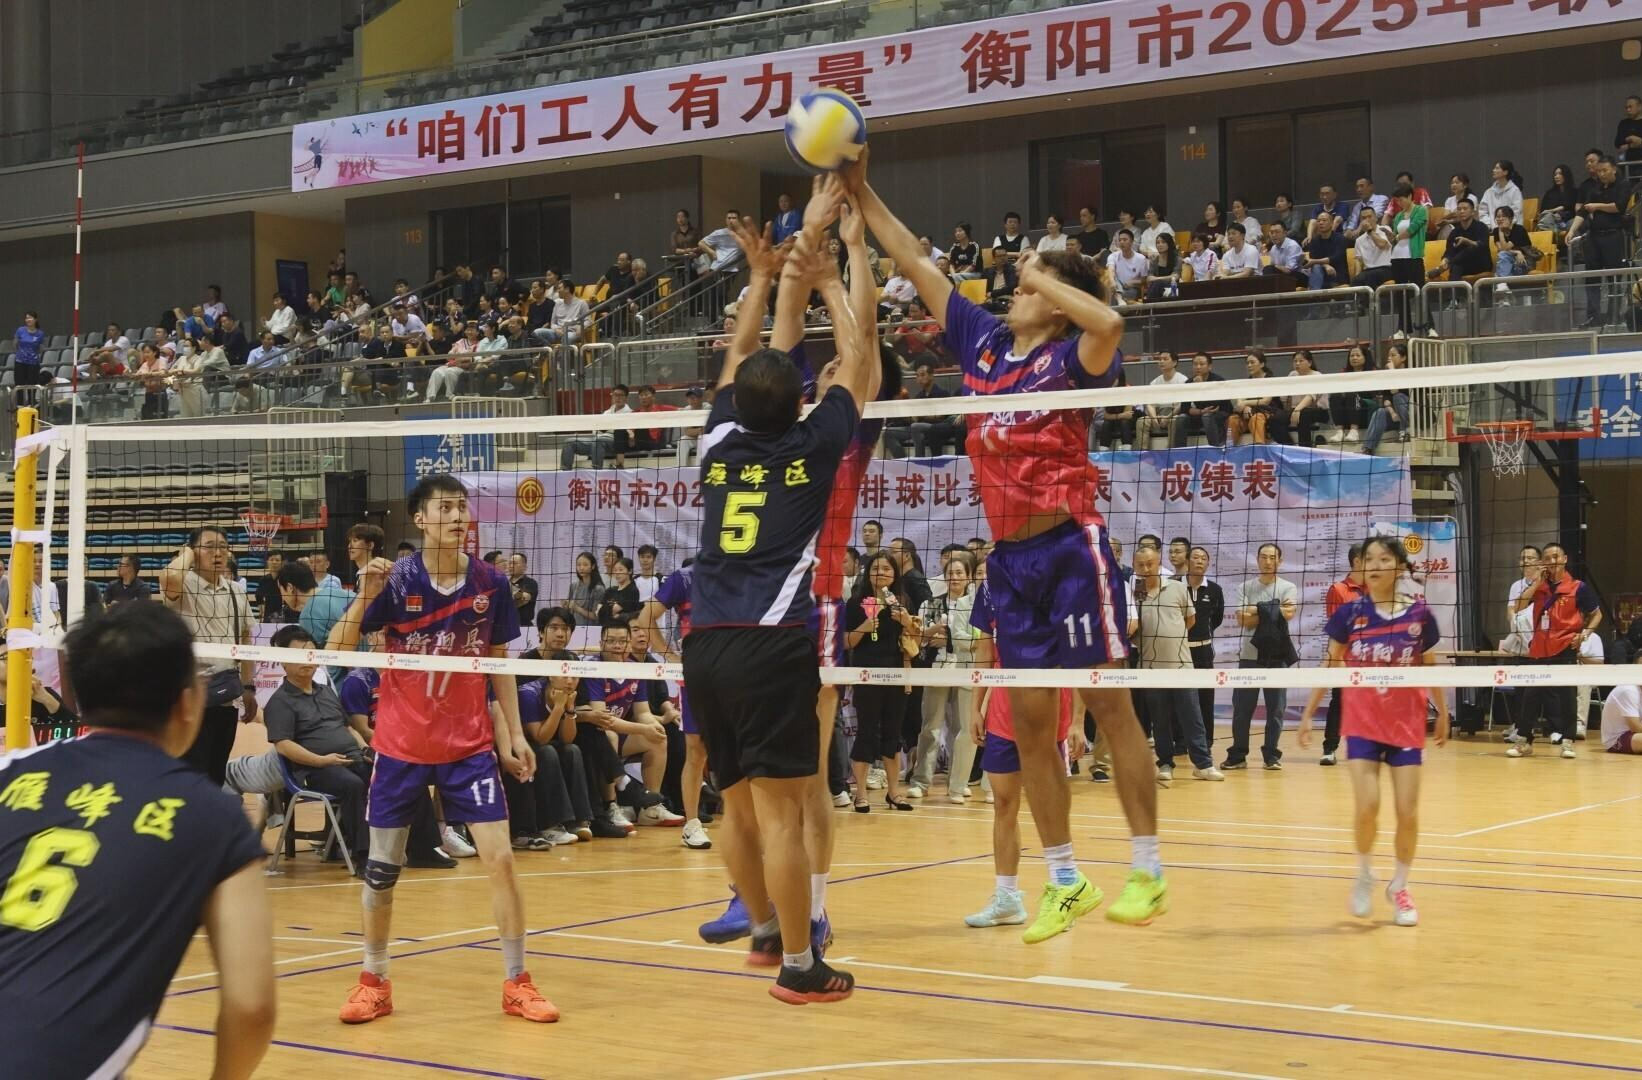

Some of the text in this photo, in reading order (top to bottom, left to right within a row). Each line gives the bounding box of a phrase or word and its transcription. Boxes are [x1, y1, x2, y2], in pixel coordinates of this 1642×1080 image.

[386, 43, 912, 163] “咱们工人有力量”
[1180, 143, 1207, 160] 114
[719, 492, 768, 554] 5
[1063, 613, 1094, 648] 11
[470, 777, 495, 806] 17
[0, 826, 101, 932] 6
